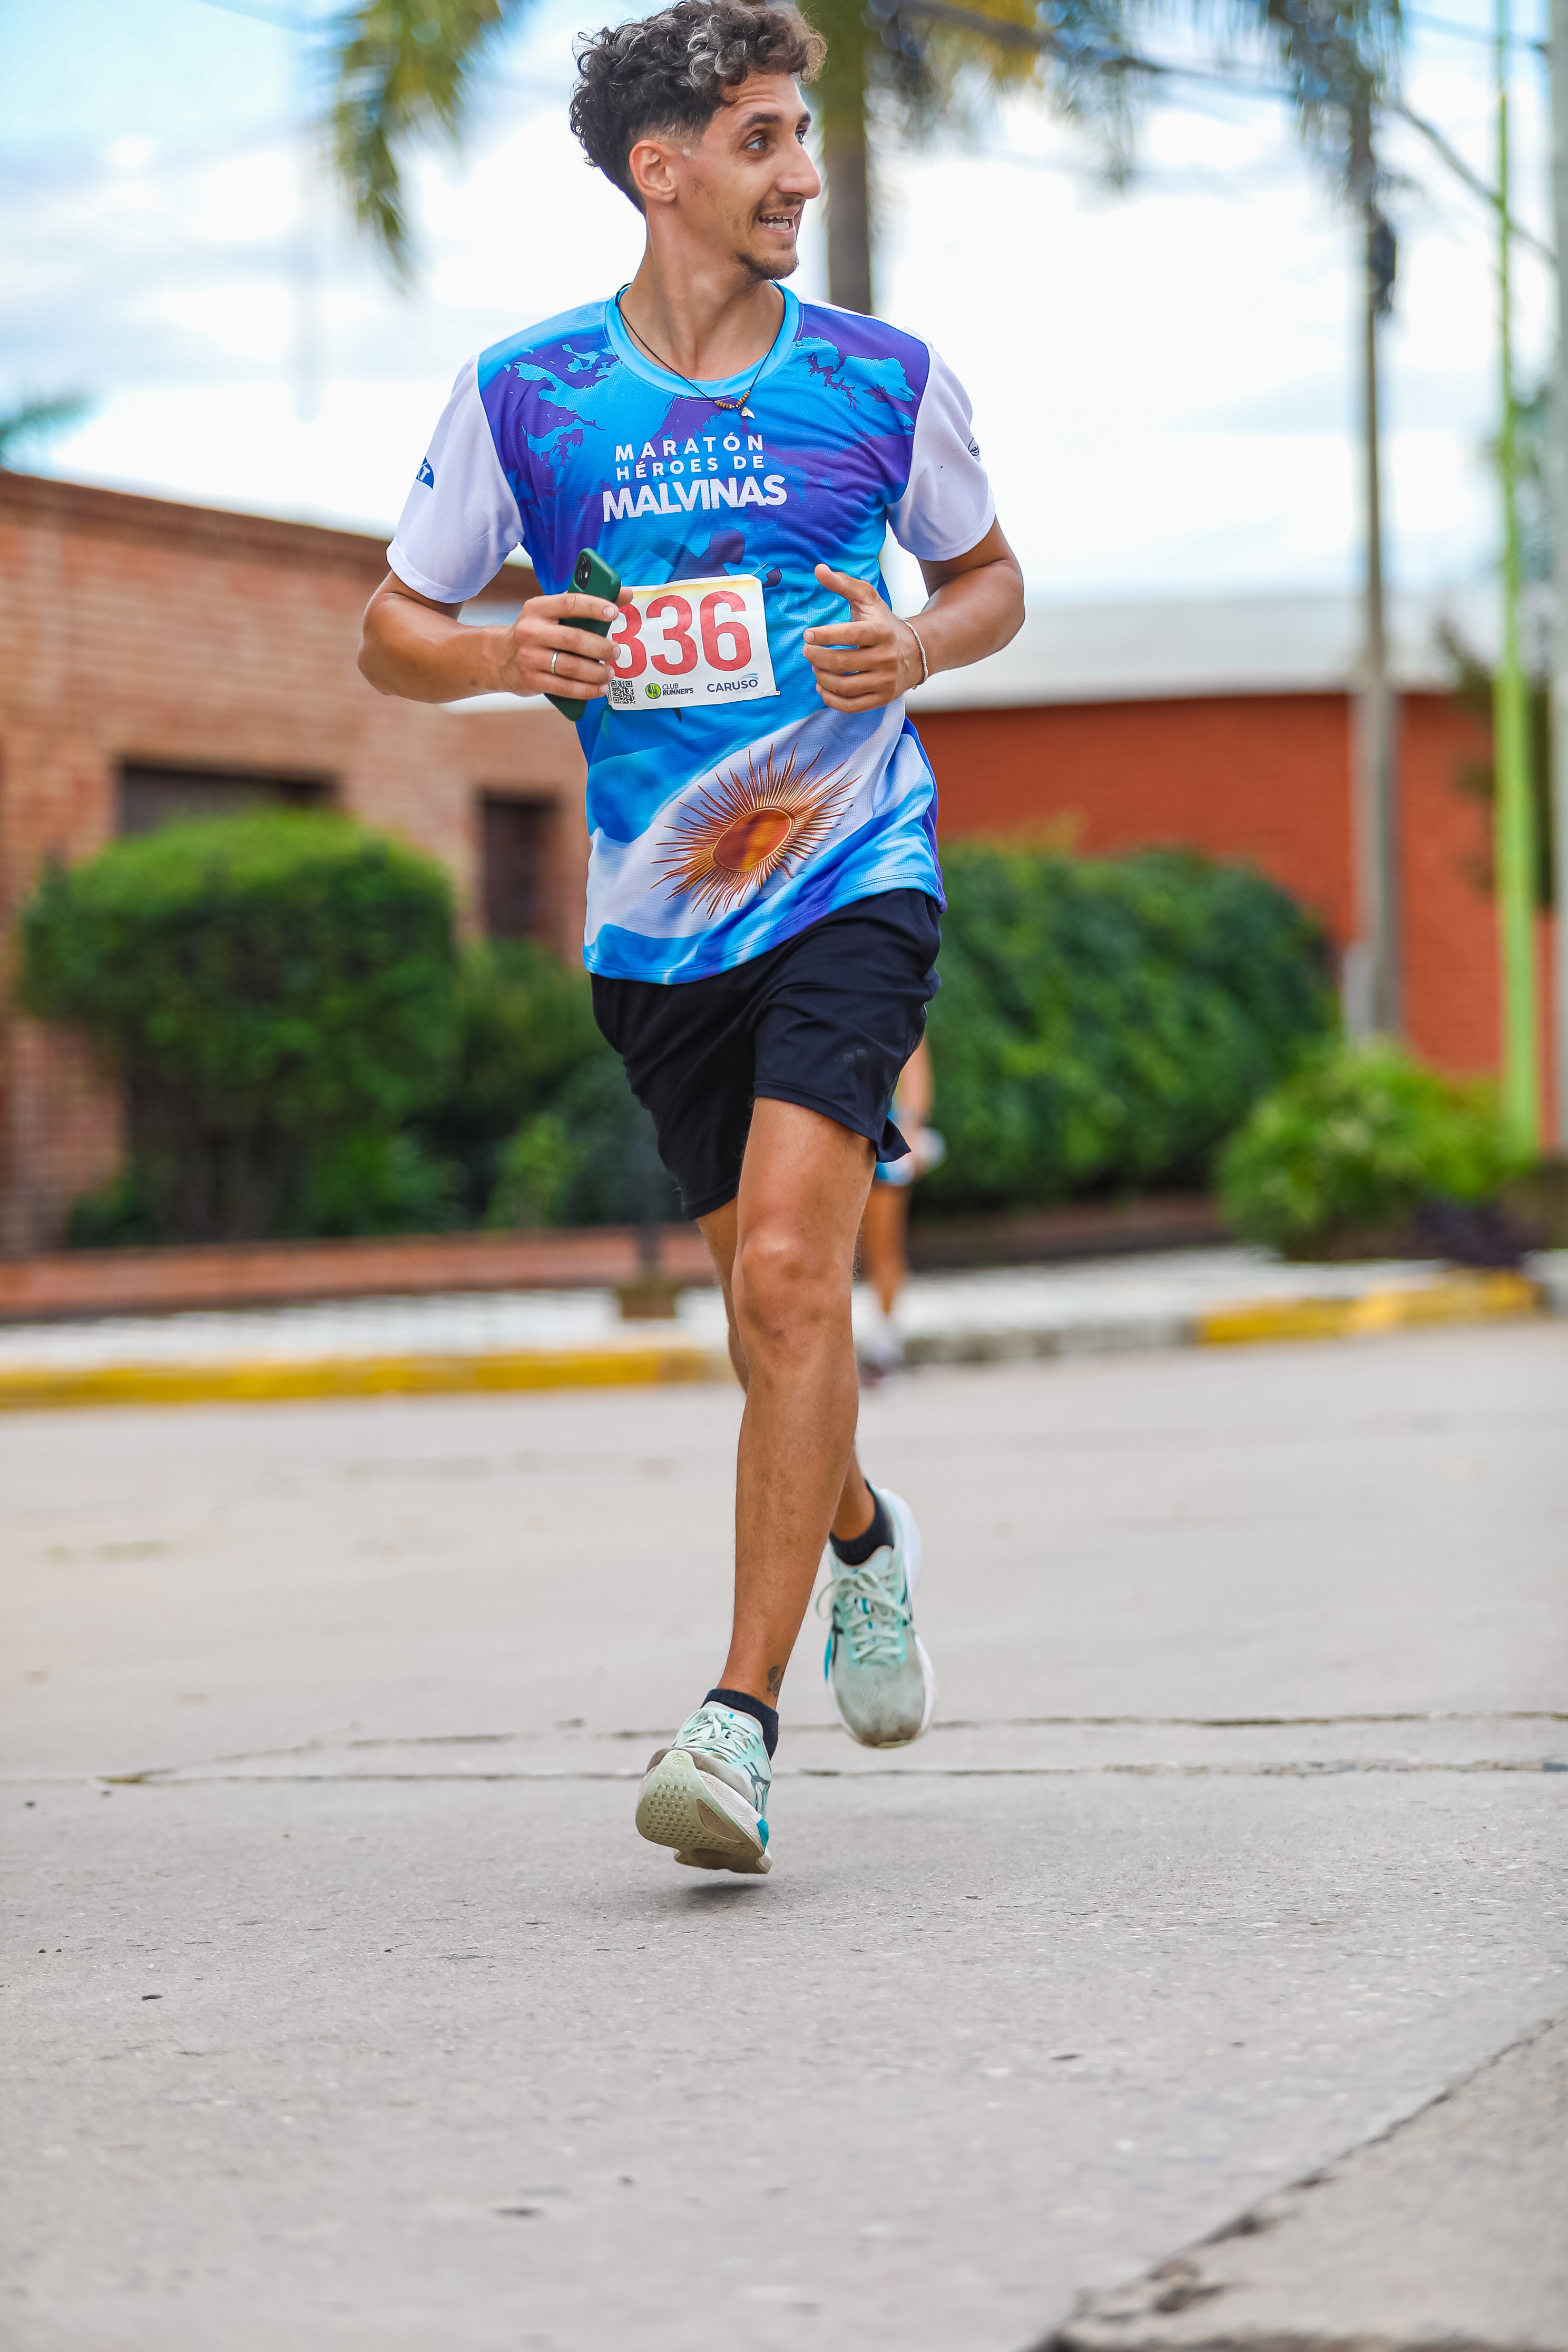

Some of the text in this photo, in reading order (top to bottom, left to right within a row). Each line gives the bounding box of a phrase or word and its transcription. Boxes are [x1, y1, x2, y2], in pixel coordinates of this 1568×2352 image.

[615, 432, 763, 462] MARATÓN
[616, 455, 765, 481] HÉROES DE
[602, 474, 787, 522] MALVINAS
[605, 591, 751, 679] 336
[662, 688, 694, 696] RUNNER'S
[707, 679, 758, 692] CARUSO
